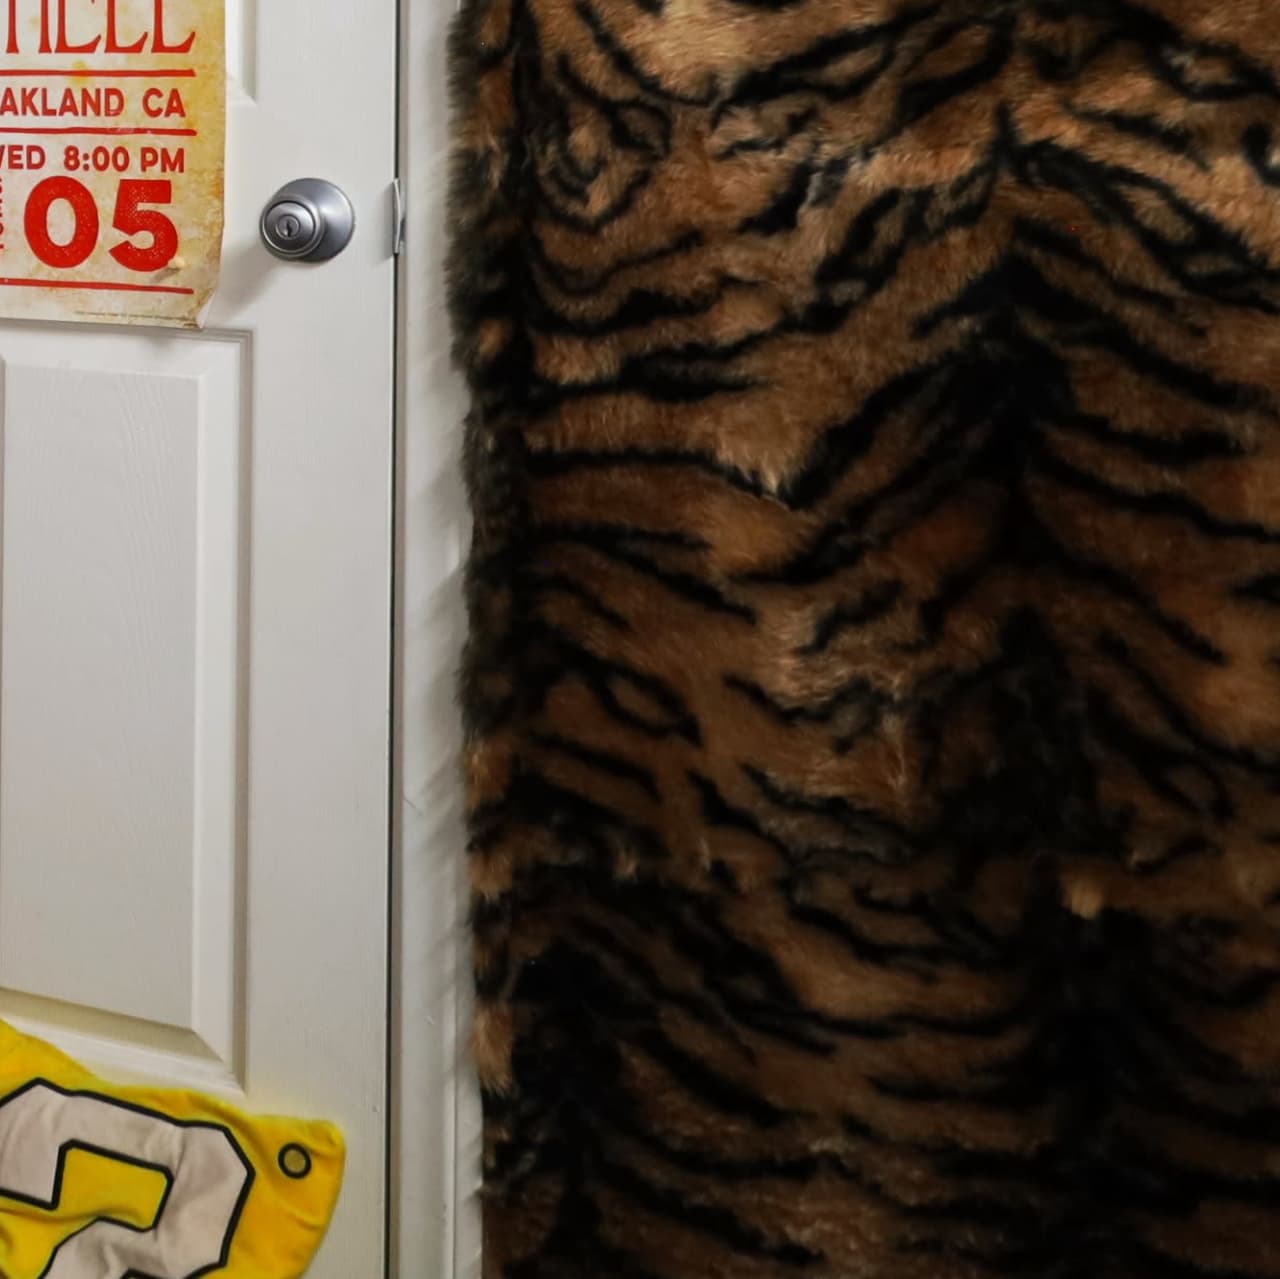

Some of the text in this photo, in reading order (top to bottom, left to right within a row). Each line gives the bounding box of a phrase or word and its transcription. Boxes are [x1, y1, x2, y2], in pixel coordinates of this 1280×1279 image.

[141, 87, 186, 119] CA
[63, 146, 130, 173] 8:00
[140, 148, 186, 174] PM
[23, 175, 180, 273] 05
